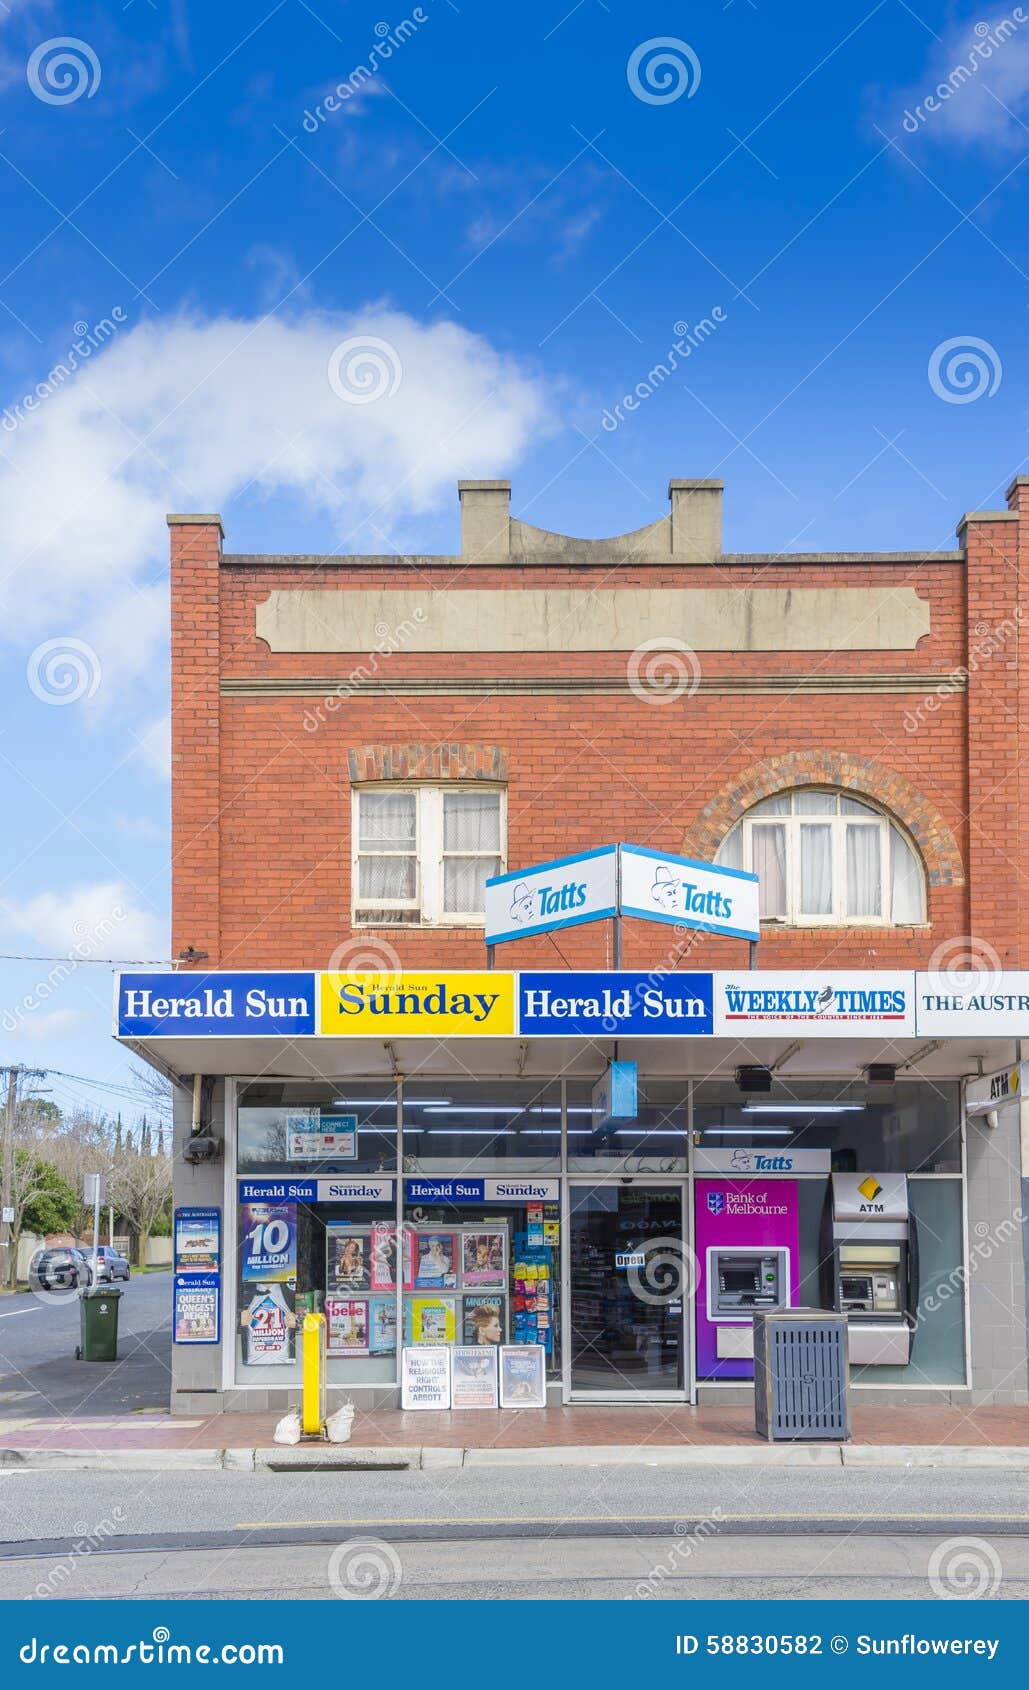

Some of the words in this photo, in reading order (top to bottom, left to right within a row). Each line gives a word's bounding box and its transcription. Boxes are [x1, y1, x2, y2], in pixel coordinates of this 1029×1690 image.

[537, 882, 587, 916] Tatts
[682, 882, 732, 919] Tatts
[371, 983, 405, 992] Herald
[408, 984, 428, 992] Sun
[124, 989, 234, 1018] Herald
[245, 989, 310, 1018] Sun
[339, 983, 500, 1022] Sunday
[524, 989, 632, 1018] Herald
[643, 989, 707, 1018] Sun
[725, 990, 818, 1013] WEEKLY
[834, 990, 906, 1013] TIMES
[922, 995, 964, 1011] THE
[990, 1073, 1009, 1100] ATM
[754, 1155, 793, 1170] Tatts
[243, 1185, 285, 1197] Herald
[288, 1185, 313, 1197] Sun
[329, 1185, 382, 1198] Sunday
[410, 1184, 452, 1196] Herald
[455, 1184, 480, 1196] Sun
[496, 1184, 549, 1198] Sunday
[727, 1193, 755, 1203] Bank
[755, 1193, 768, 1203] of
[726, 1203, 788, 1215] Melbourne
[859, 1204, 884, 1213] ATM
[249, 1219, 289, 1255] 10
[247, 1254, 289, 1265] MILLION
[616, 1254, 644, 1265] Open
[177, 1278, 201, 1286] erald
[179, 1295, 215, 1304] QUEEN'S
[177, 1304, 216, 1312] LONGEST
[331, 1301, 364, 1316] belle
[184, 1312, 210, 1320] REIGN
[254, 1307, 284, 1329] 21
[252, 1328, 284, 1336] MILLION
[413, 1393, 442, 1401] ABBOTT
